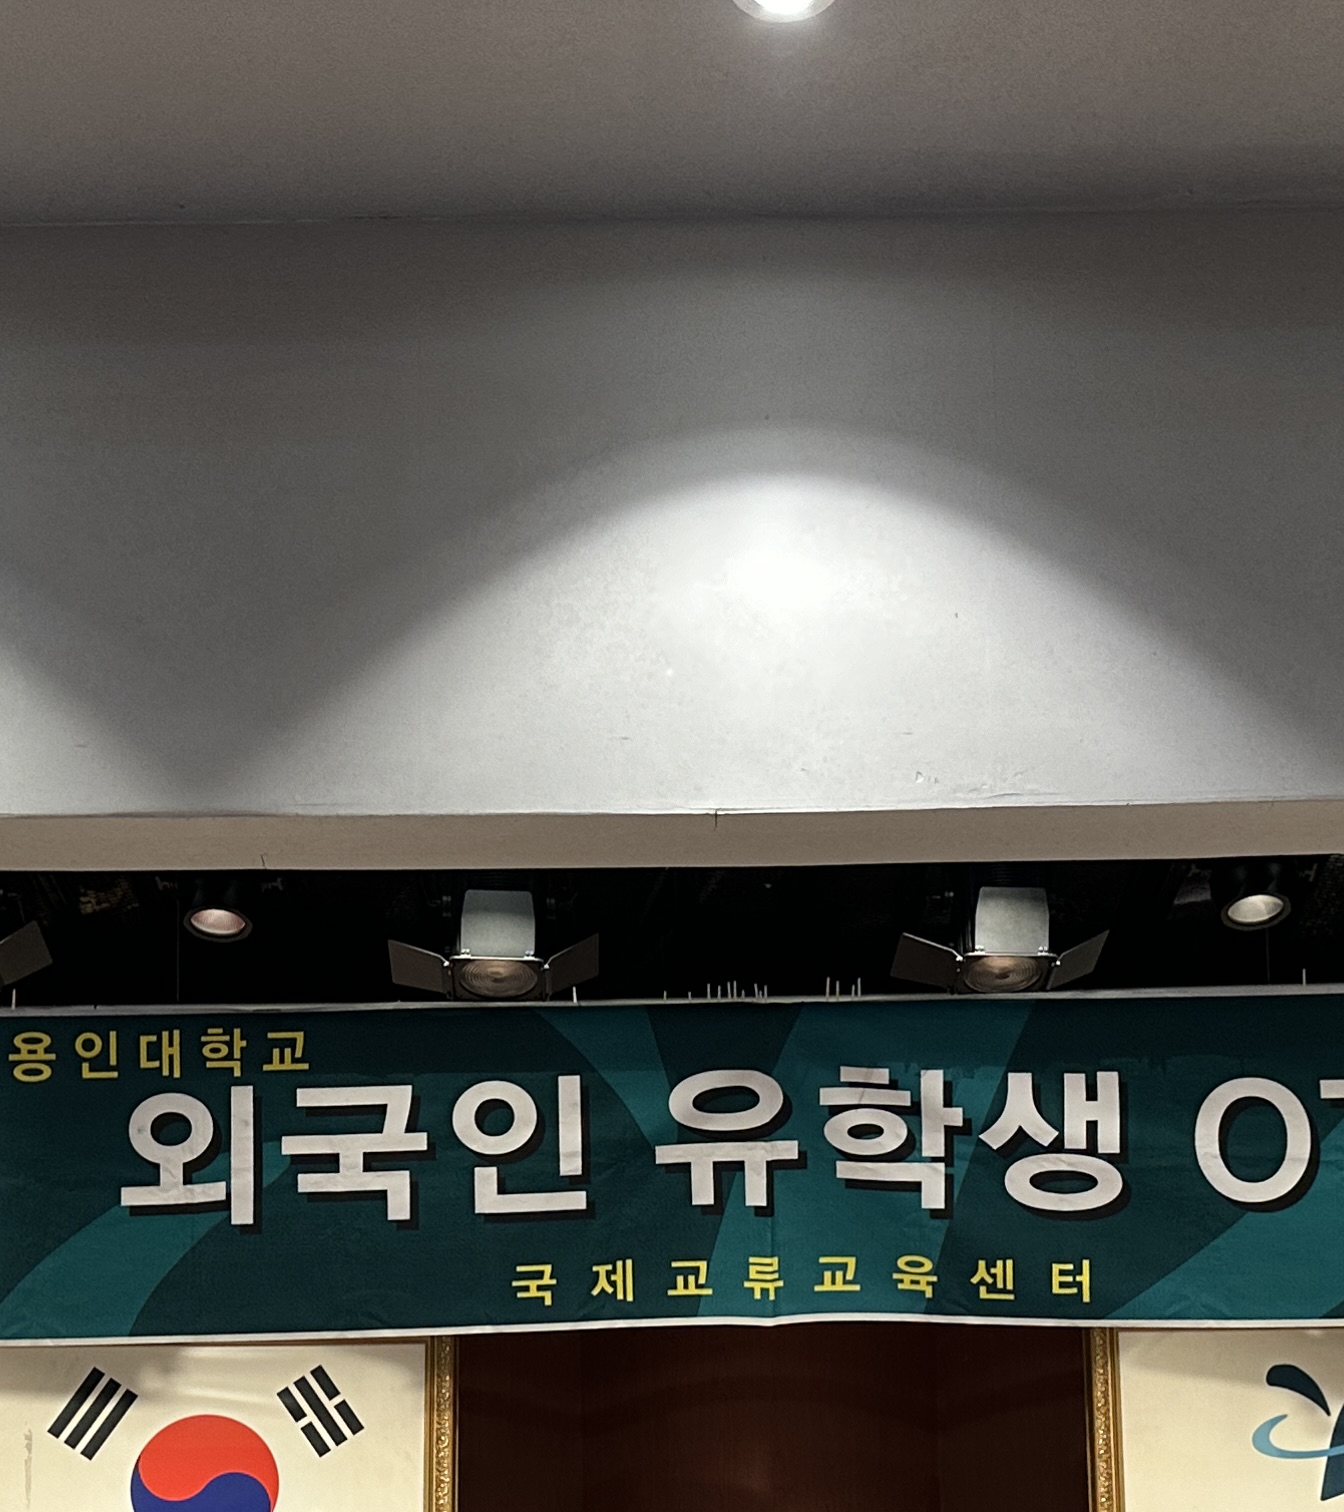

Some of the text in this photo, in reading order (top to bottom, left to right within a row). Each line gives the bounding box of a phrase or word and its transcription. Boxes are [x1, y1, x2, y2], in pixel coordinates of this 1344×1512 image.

[7, 1026, 310, 1082] 용인대학교
[120, 1074, 587, 1225] 외국인
[655, 1065, 1123, 1213] 유학생
[511, 1254, 1092, 1306] 국제교류교육센터
